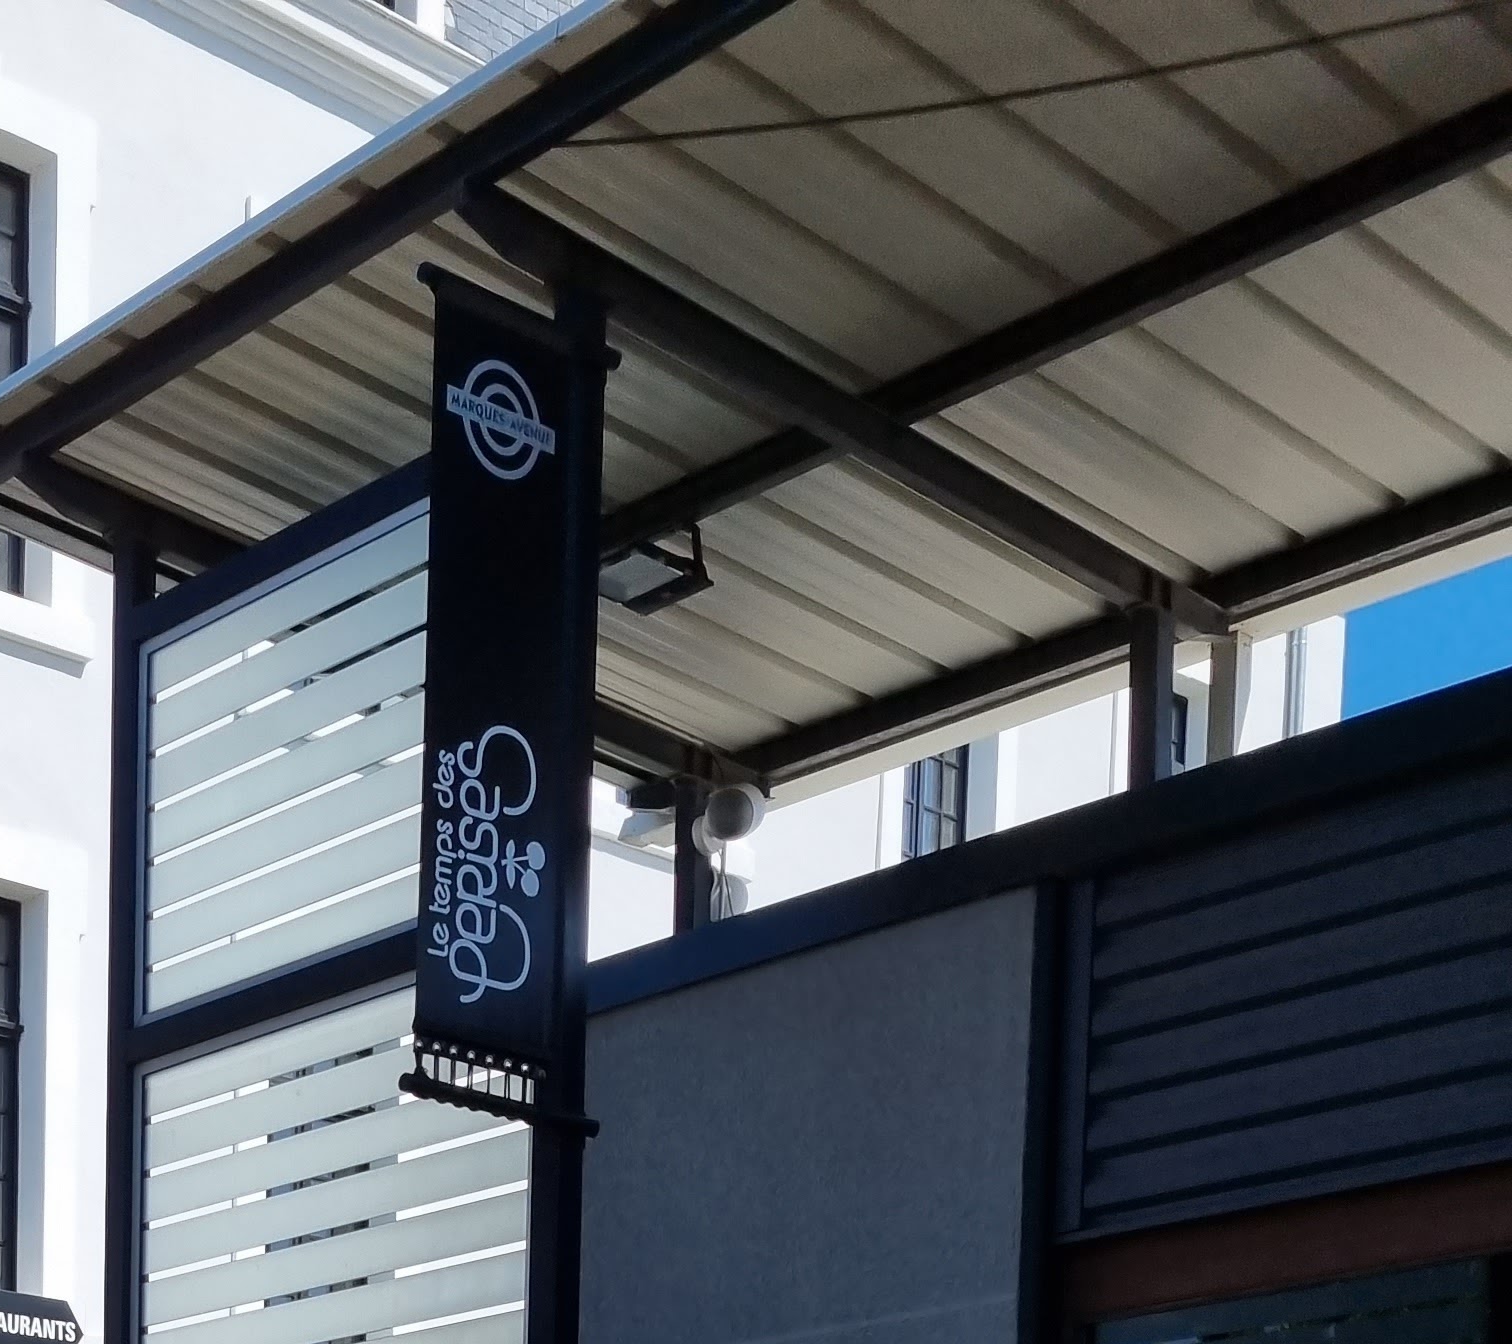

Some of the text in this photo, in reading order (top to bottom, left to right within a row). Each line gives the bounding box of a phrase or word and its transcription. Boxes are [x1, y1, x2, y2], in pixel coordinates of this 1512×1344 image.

[451, 392, 507, 424] MARQUES
[433, 750, 455, 809] des
[428, 819, 457, 914] temps
